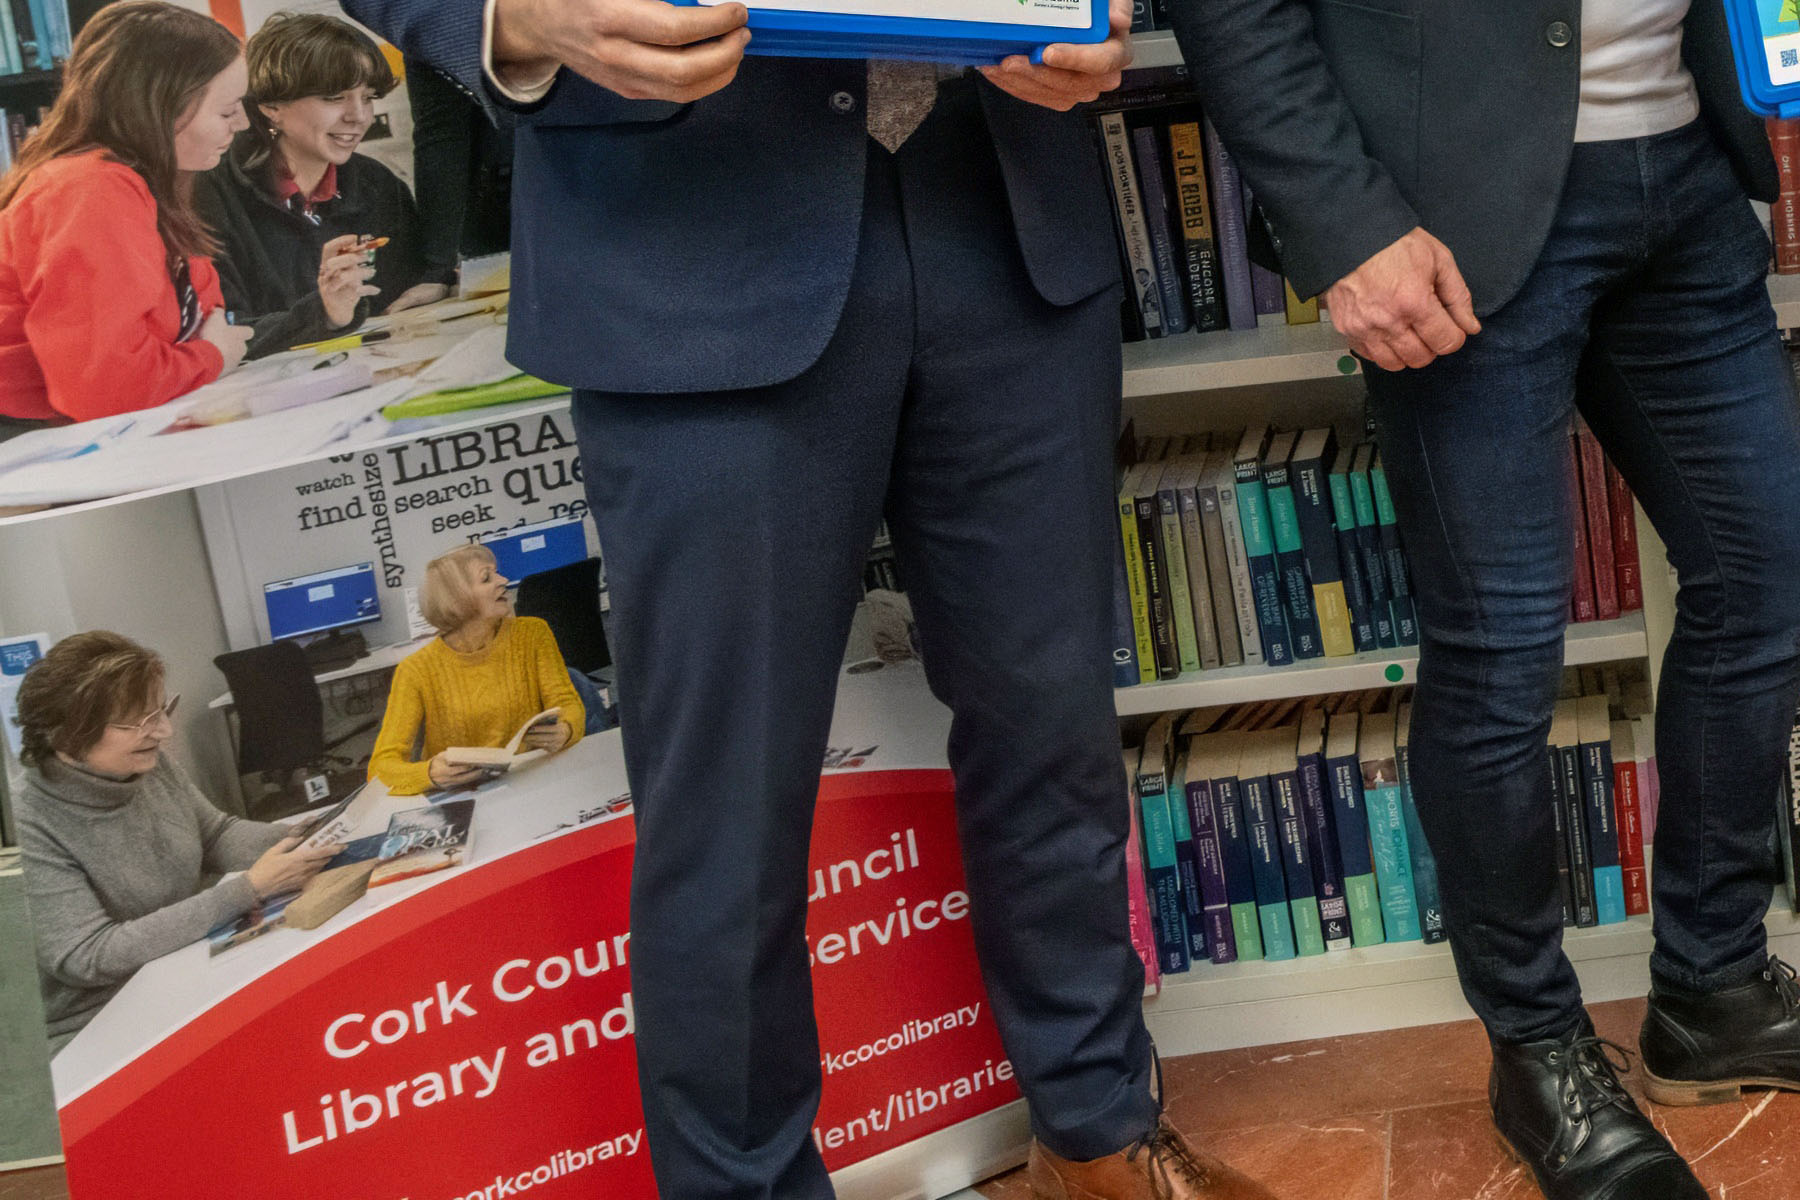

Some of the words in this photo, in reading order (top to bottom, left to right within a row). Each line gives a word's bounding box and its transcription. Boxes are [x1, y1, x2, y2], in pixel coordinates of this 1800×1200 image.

[1182, 184, 1203, 228] ROBB
[1190, 261, 1201, 308] DEATH
[1200, 250, 1214, 304] ENCORE
[388, 414, 578, 486] LIBRA
[296, 472, 355, 496] watch
[394, 475, 493, 513] search
[503, 457, 585, 505] que
[298, 498, 366, 530] find
[364, 452, 402, 588] synthesize
[431, 505, 495, 533] seek
[323, 979, 476, 1060] Cork
[282, 1046, 507, 1155] Library
[526, 994, 636, 1068] and
